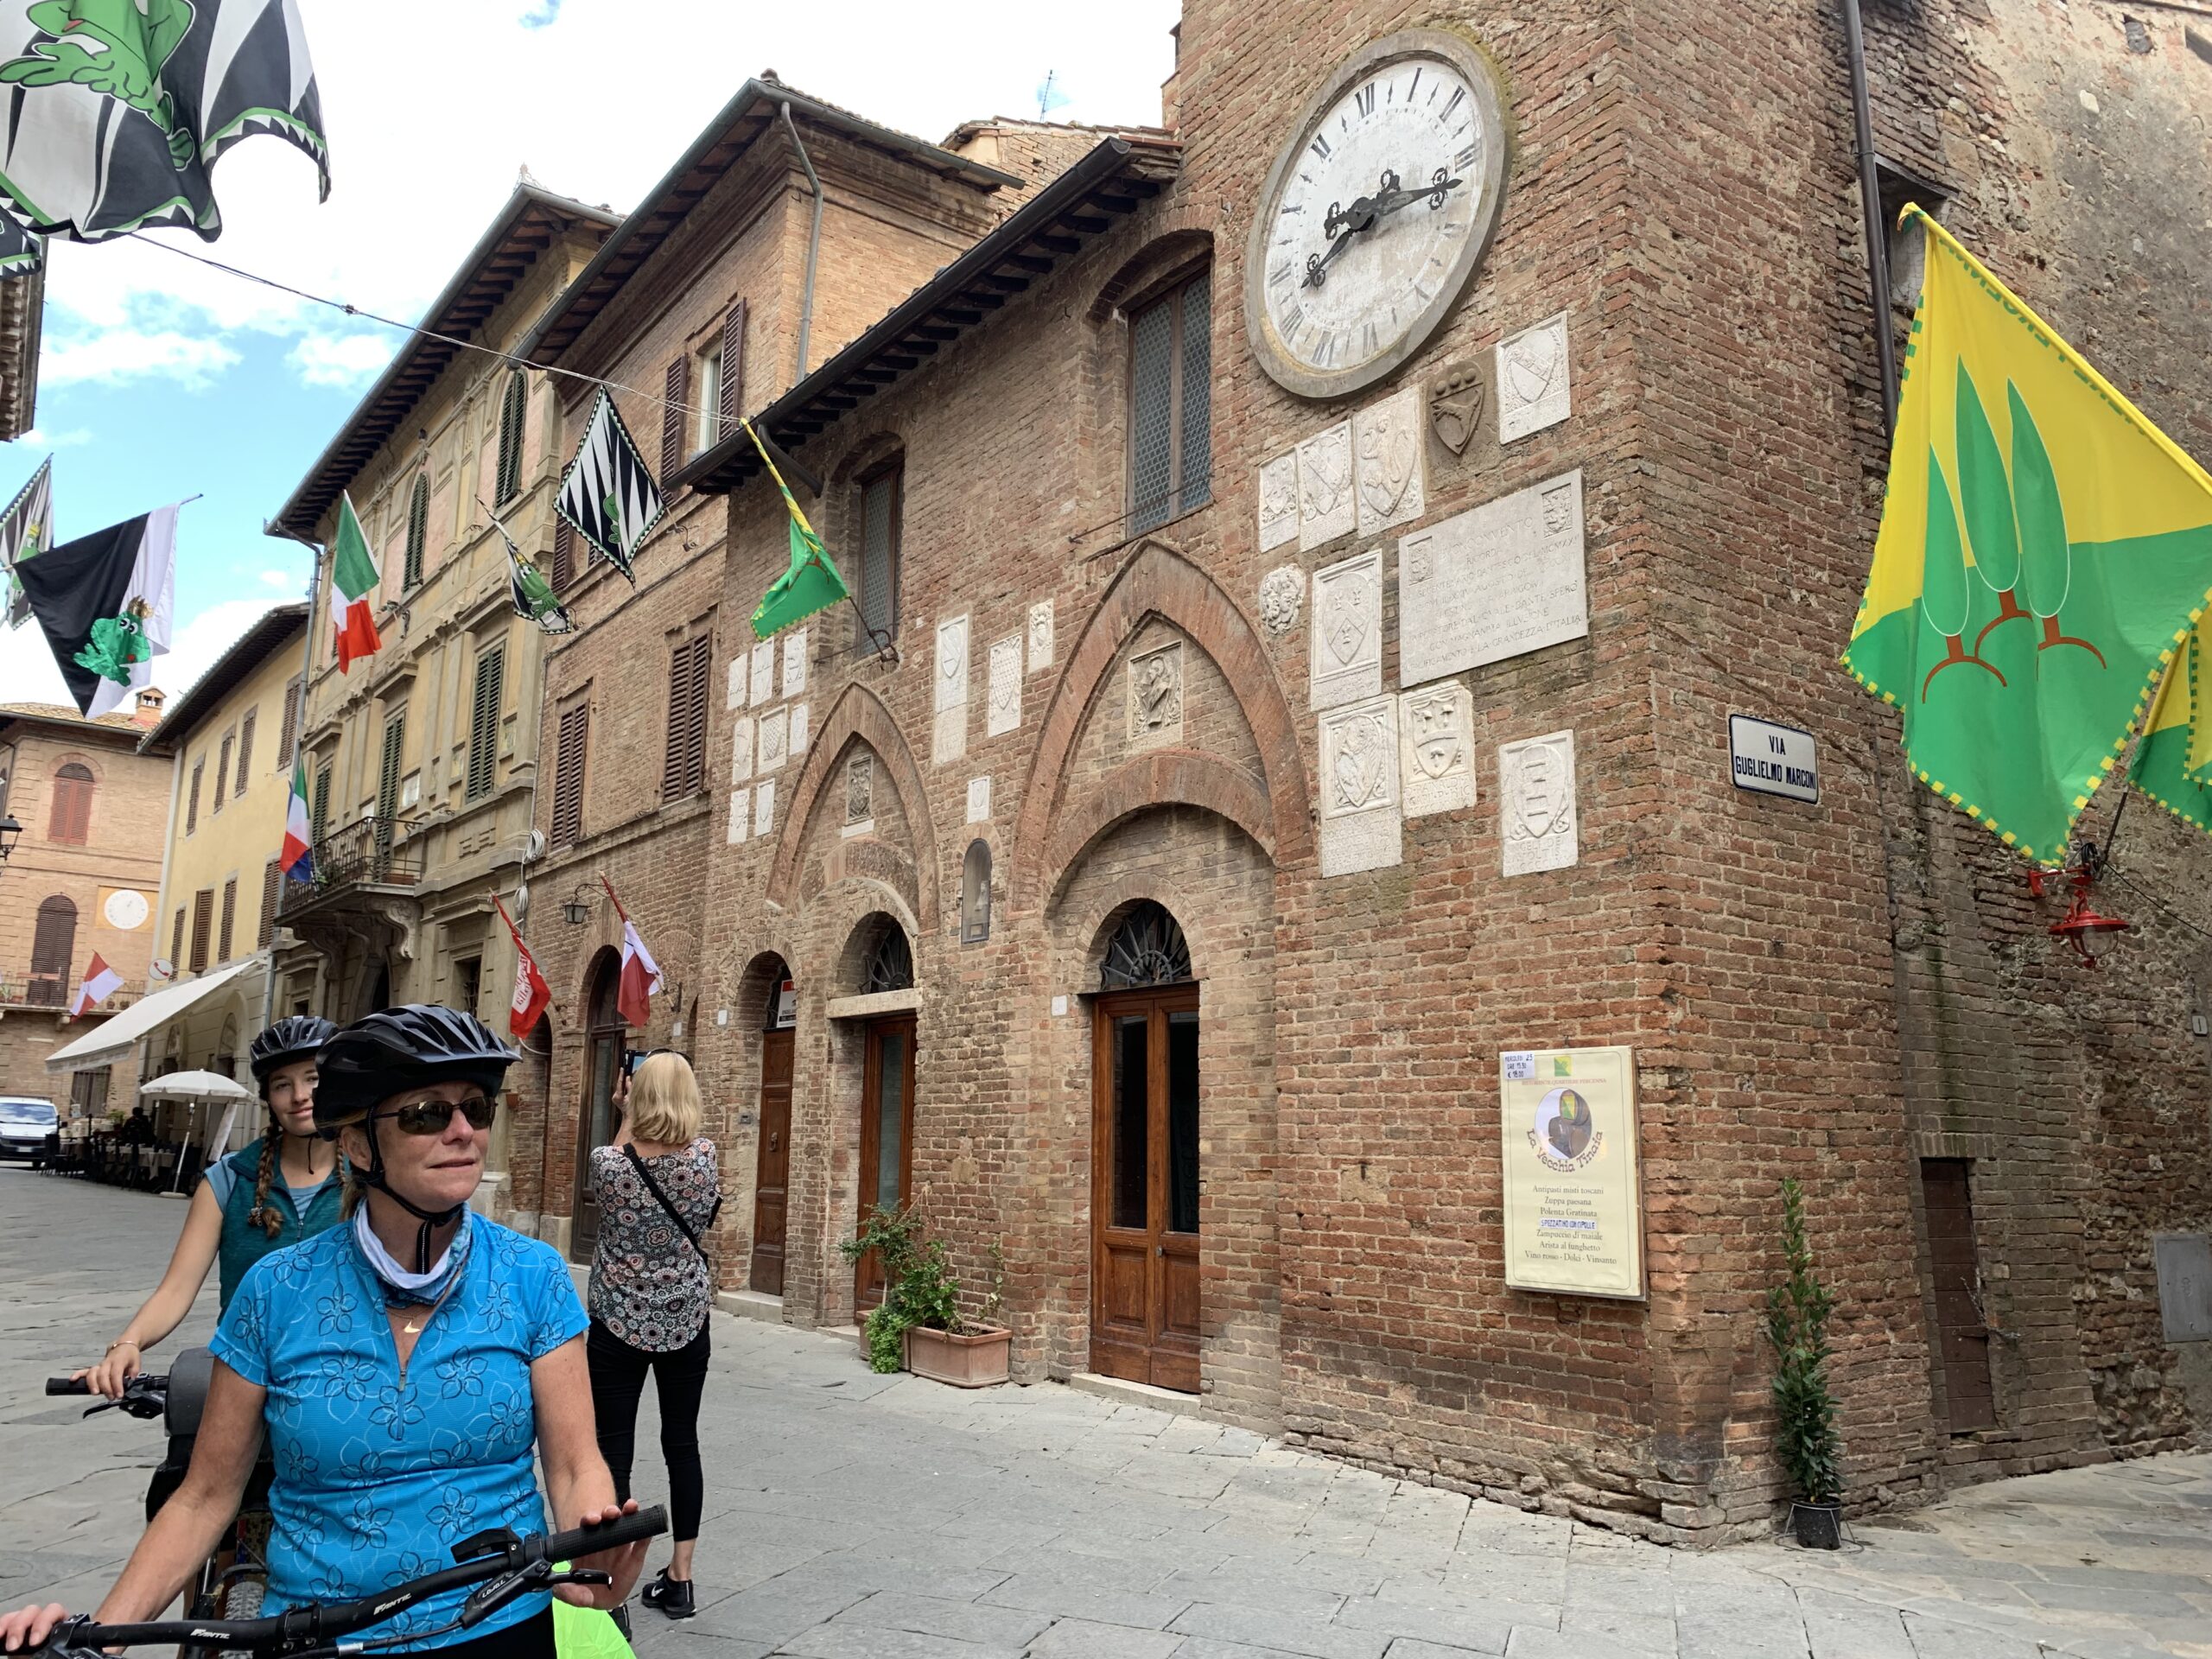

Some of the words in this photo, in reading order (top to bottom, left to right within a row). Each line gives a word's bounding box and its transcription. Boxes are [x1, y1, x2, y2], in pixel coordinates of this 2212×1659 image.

[1769, 734, 1786, 755] VIA
[1735, 755, 1783, 783] GUGLIELMO
[1786, 766, 1816, 790] MARCONI
[1526, 1128, 1536, 1149] La
[1536, 1147, 1575, 1173] Vecchia
[1576, 1131, 1603, 1168] Tinaia
[1533, 1185, 1561, 1194] Antipasti
[1580, 1185, 1604, 1194] toscani
[1545, 1196, 1565, 1206] Zuppa
[1541, 1206, 1565, 1216] Polenta
[1566, 1208, 1597, 1217] Gratinata
[1536, 1230, 1572, 1238] Zampuccio
[1573, 1230, 1580, 1239] di
[1581, 1231, 1603, 1241] maiale
[1567, 1242, 1600, 1251] funghetto
[1564, 1253, 1581, 1262] Dolci
[1586, 1255, 1618, 1264] Vinsanto
[373, 1592, 412, 1616] FANTIC
[190, 1629, 230, 1640] FANTIC
